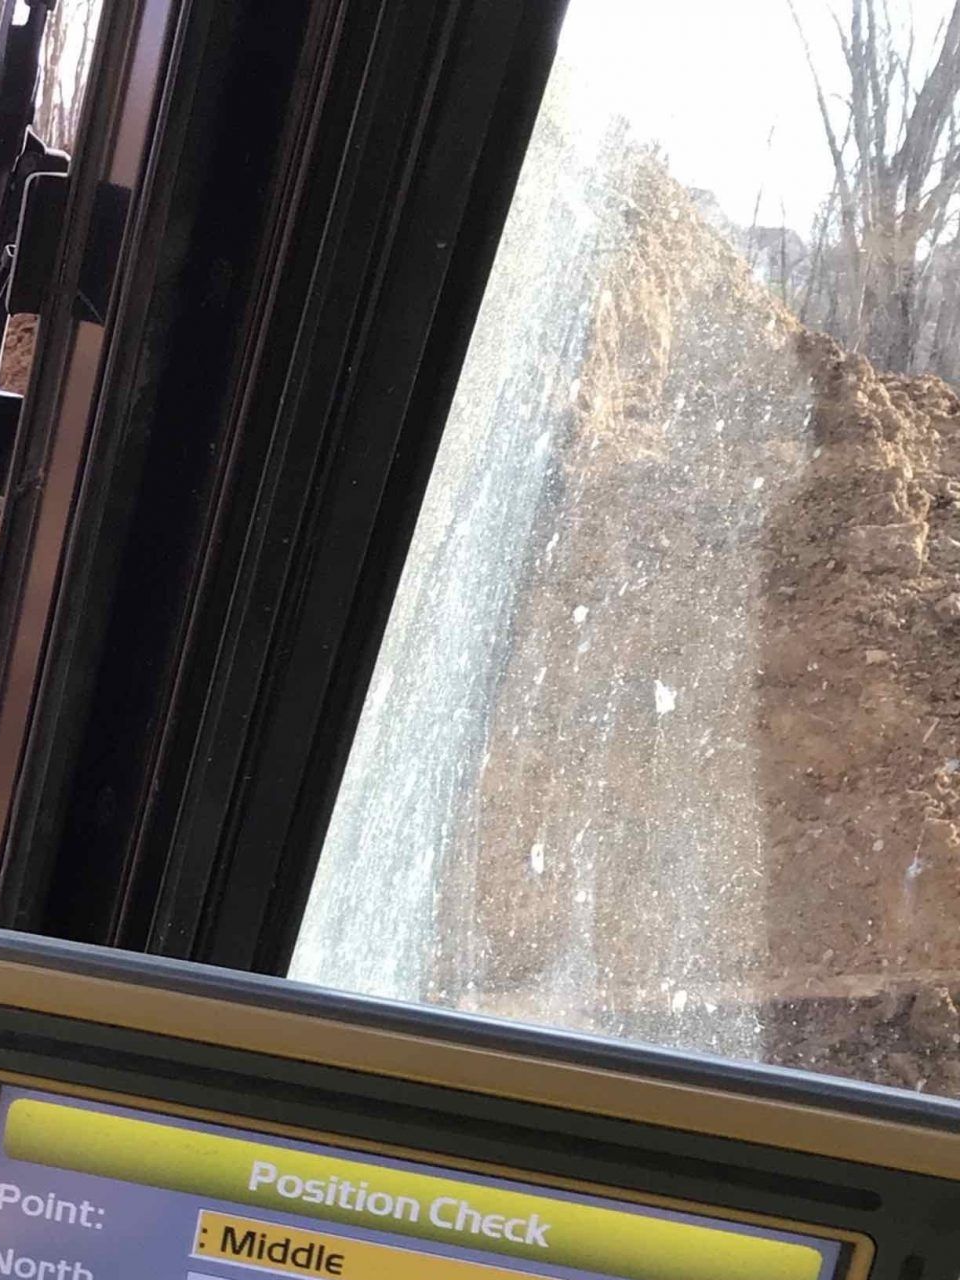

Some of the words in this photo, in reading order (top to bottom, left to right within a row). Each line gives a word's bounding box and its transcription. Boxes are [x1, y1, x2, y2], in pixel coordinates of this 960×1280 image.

[248, 1160, 421, 1223] Position
[427, 1195, 553, 1249] Check
[219, 1225, 346, 1276] Middle
